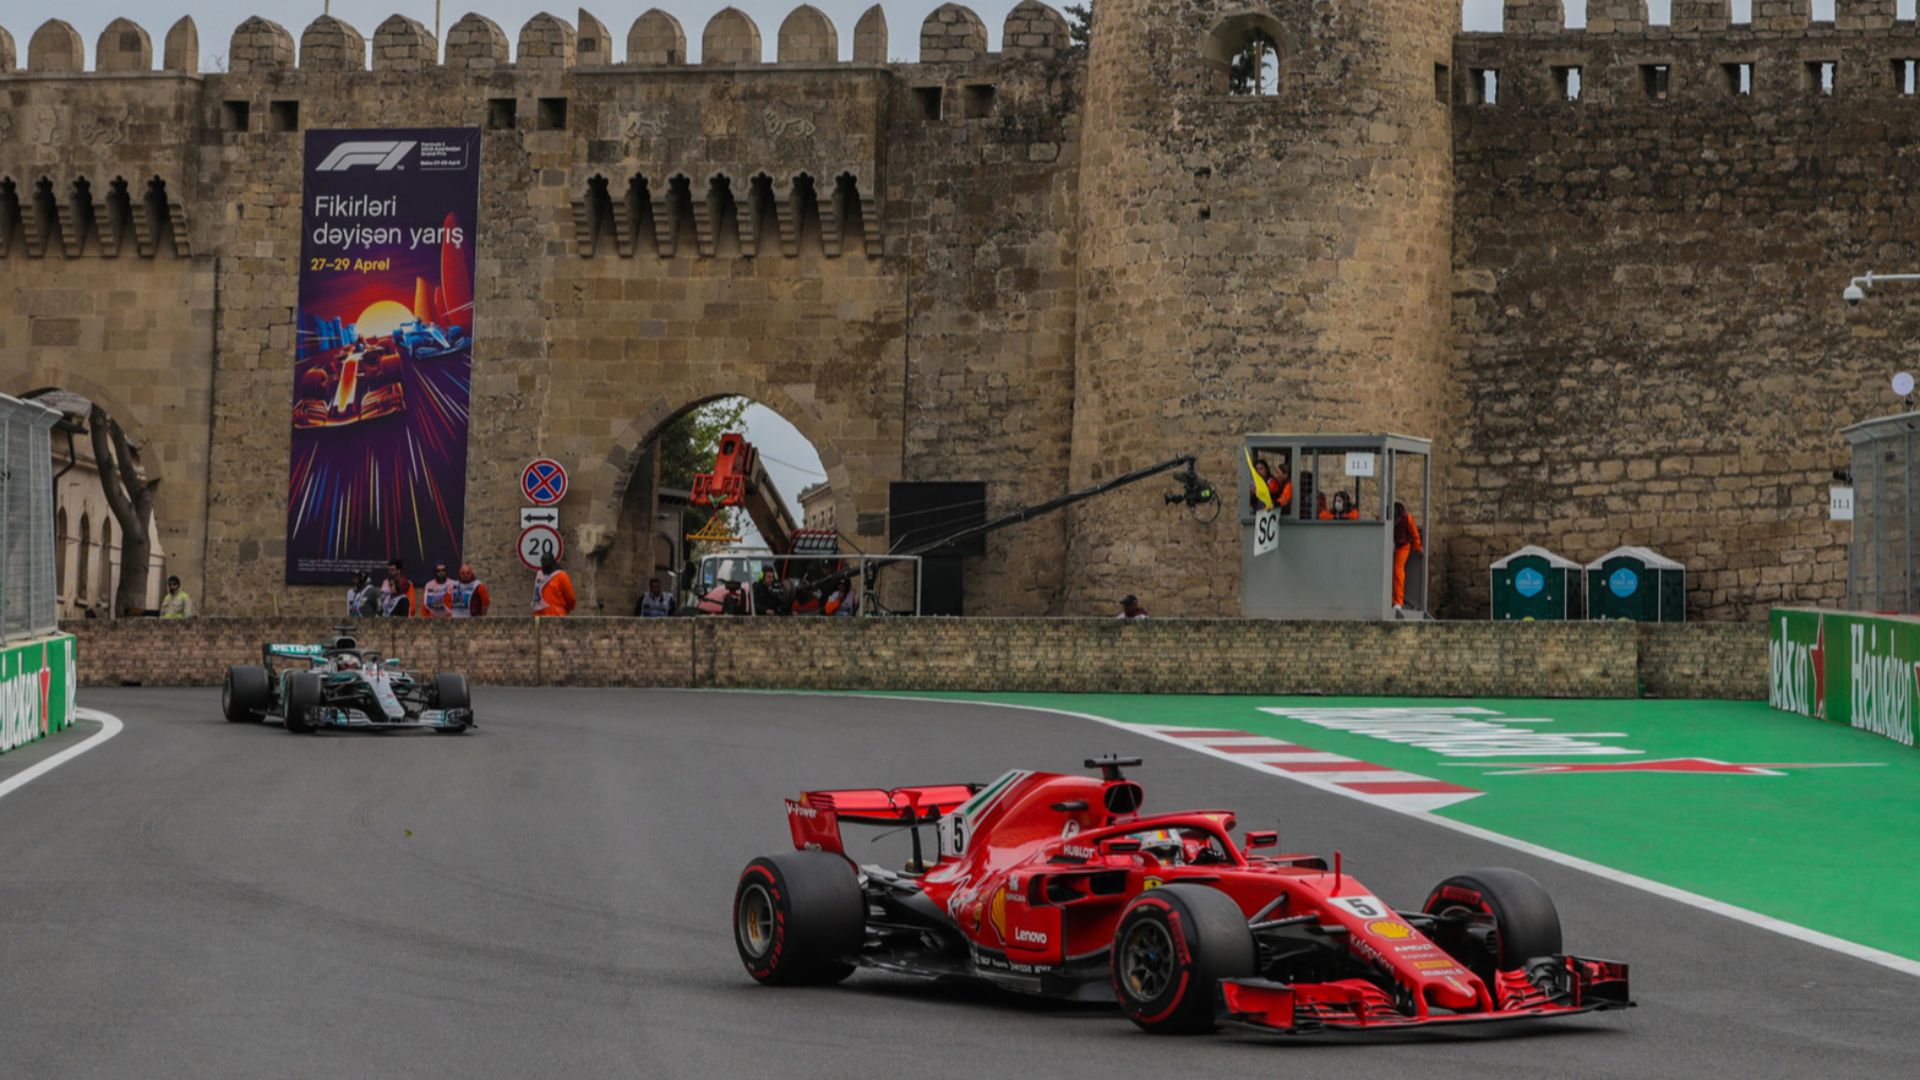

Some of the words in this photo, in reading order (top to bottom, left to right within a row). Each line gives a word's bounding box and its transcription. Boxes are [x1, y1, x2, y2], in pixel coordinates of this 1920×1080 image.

[315, 194, 396, 217] Fikirləri
[313, 222, 401, 250] dəyişən
[410, 227, 463, 249] yarış
[353, 257, 390, 273] Aprel
[1258, 514, 1277, 545] SC
[528, 538, 553, 556] 20
[1850, 624, 1914, 746] Heineken
[0, 651, 39, 752] ineken
[786, 801, 817, 818] V-Power
[953, 817, 963, 854] 5
[1063, 845, 1095, 858] HUBLOT
[1346, 898, 1378, 916] 5
[1015, 927, 1047, 944] Lenovo
